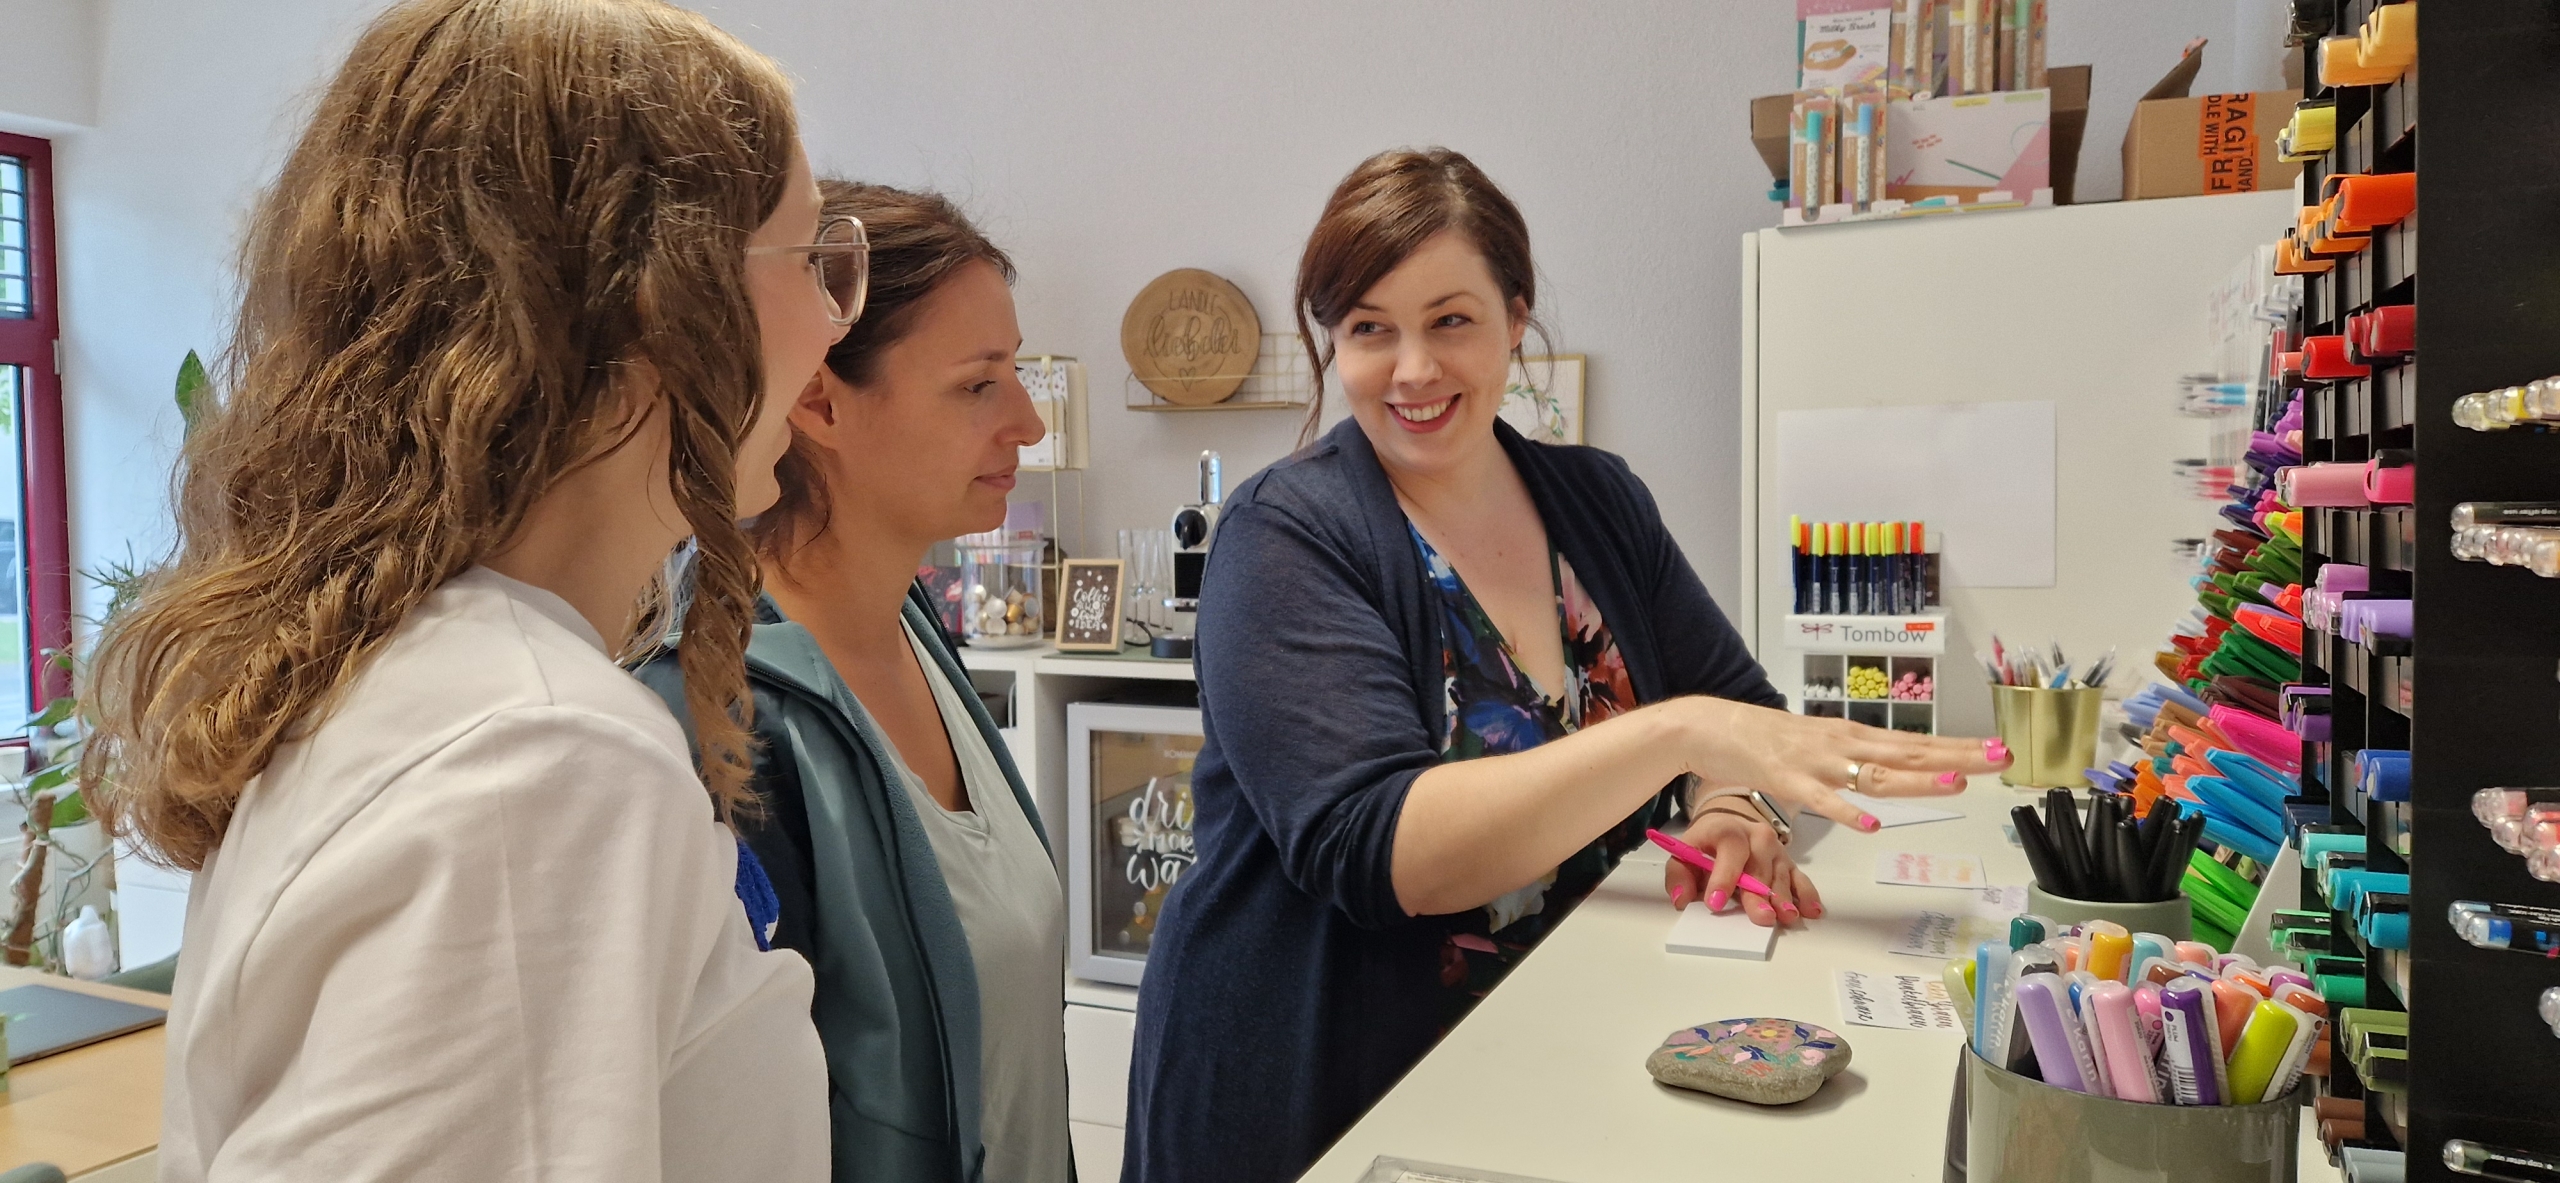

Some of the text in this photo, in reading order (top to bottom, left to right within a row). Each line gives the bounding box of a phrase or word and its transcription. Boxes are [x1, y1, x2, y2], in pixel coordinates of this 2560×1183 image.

[2203, 123, 2219, 155] WITH
[1840, 625, 1927, 643] Tombow
[1129, 777, 1195, 831] dri
[1994, 997, 2010, 1048] karin
[2072, 1026, 2098, 1083] karin
